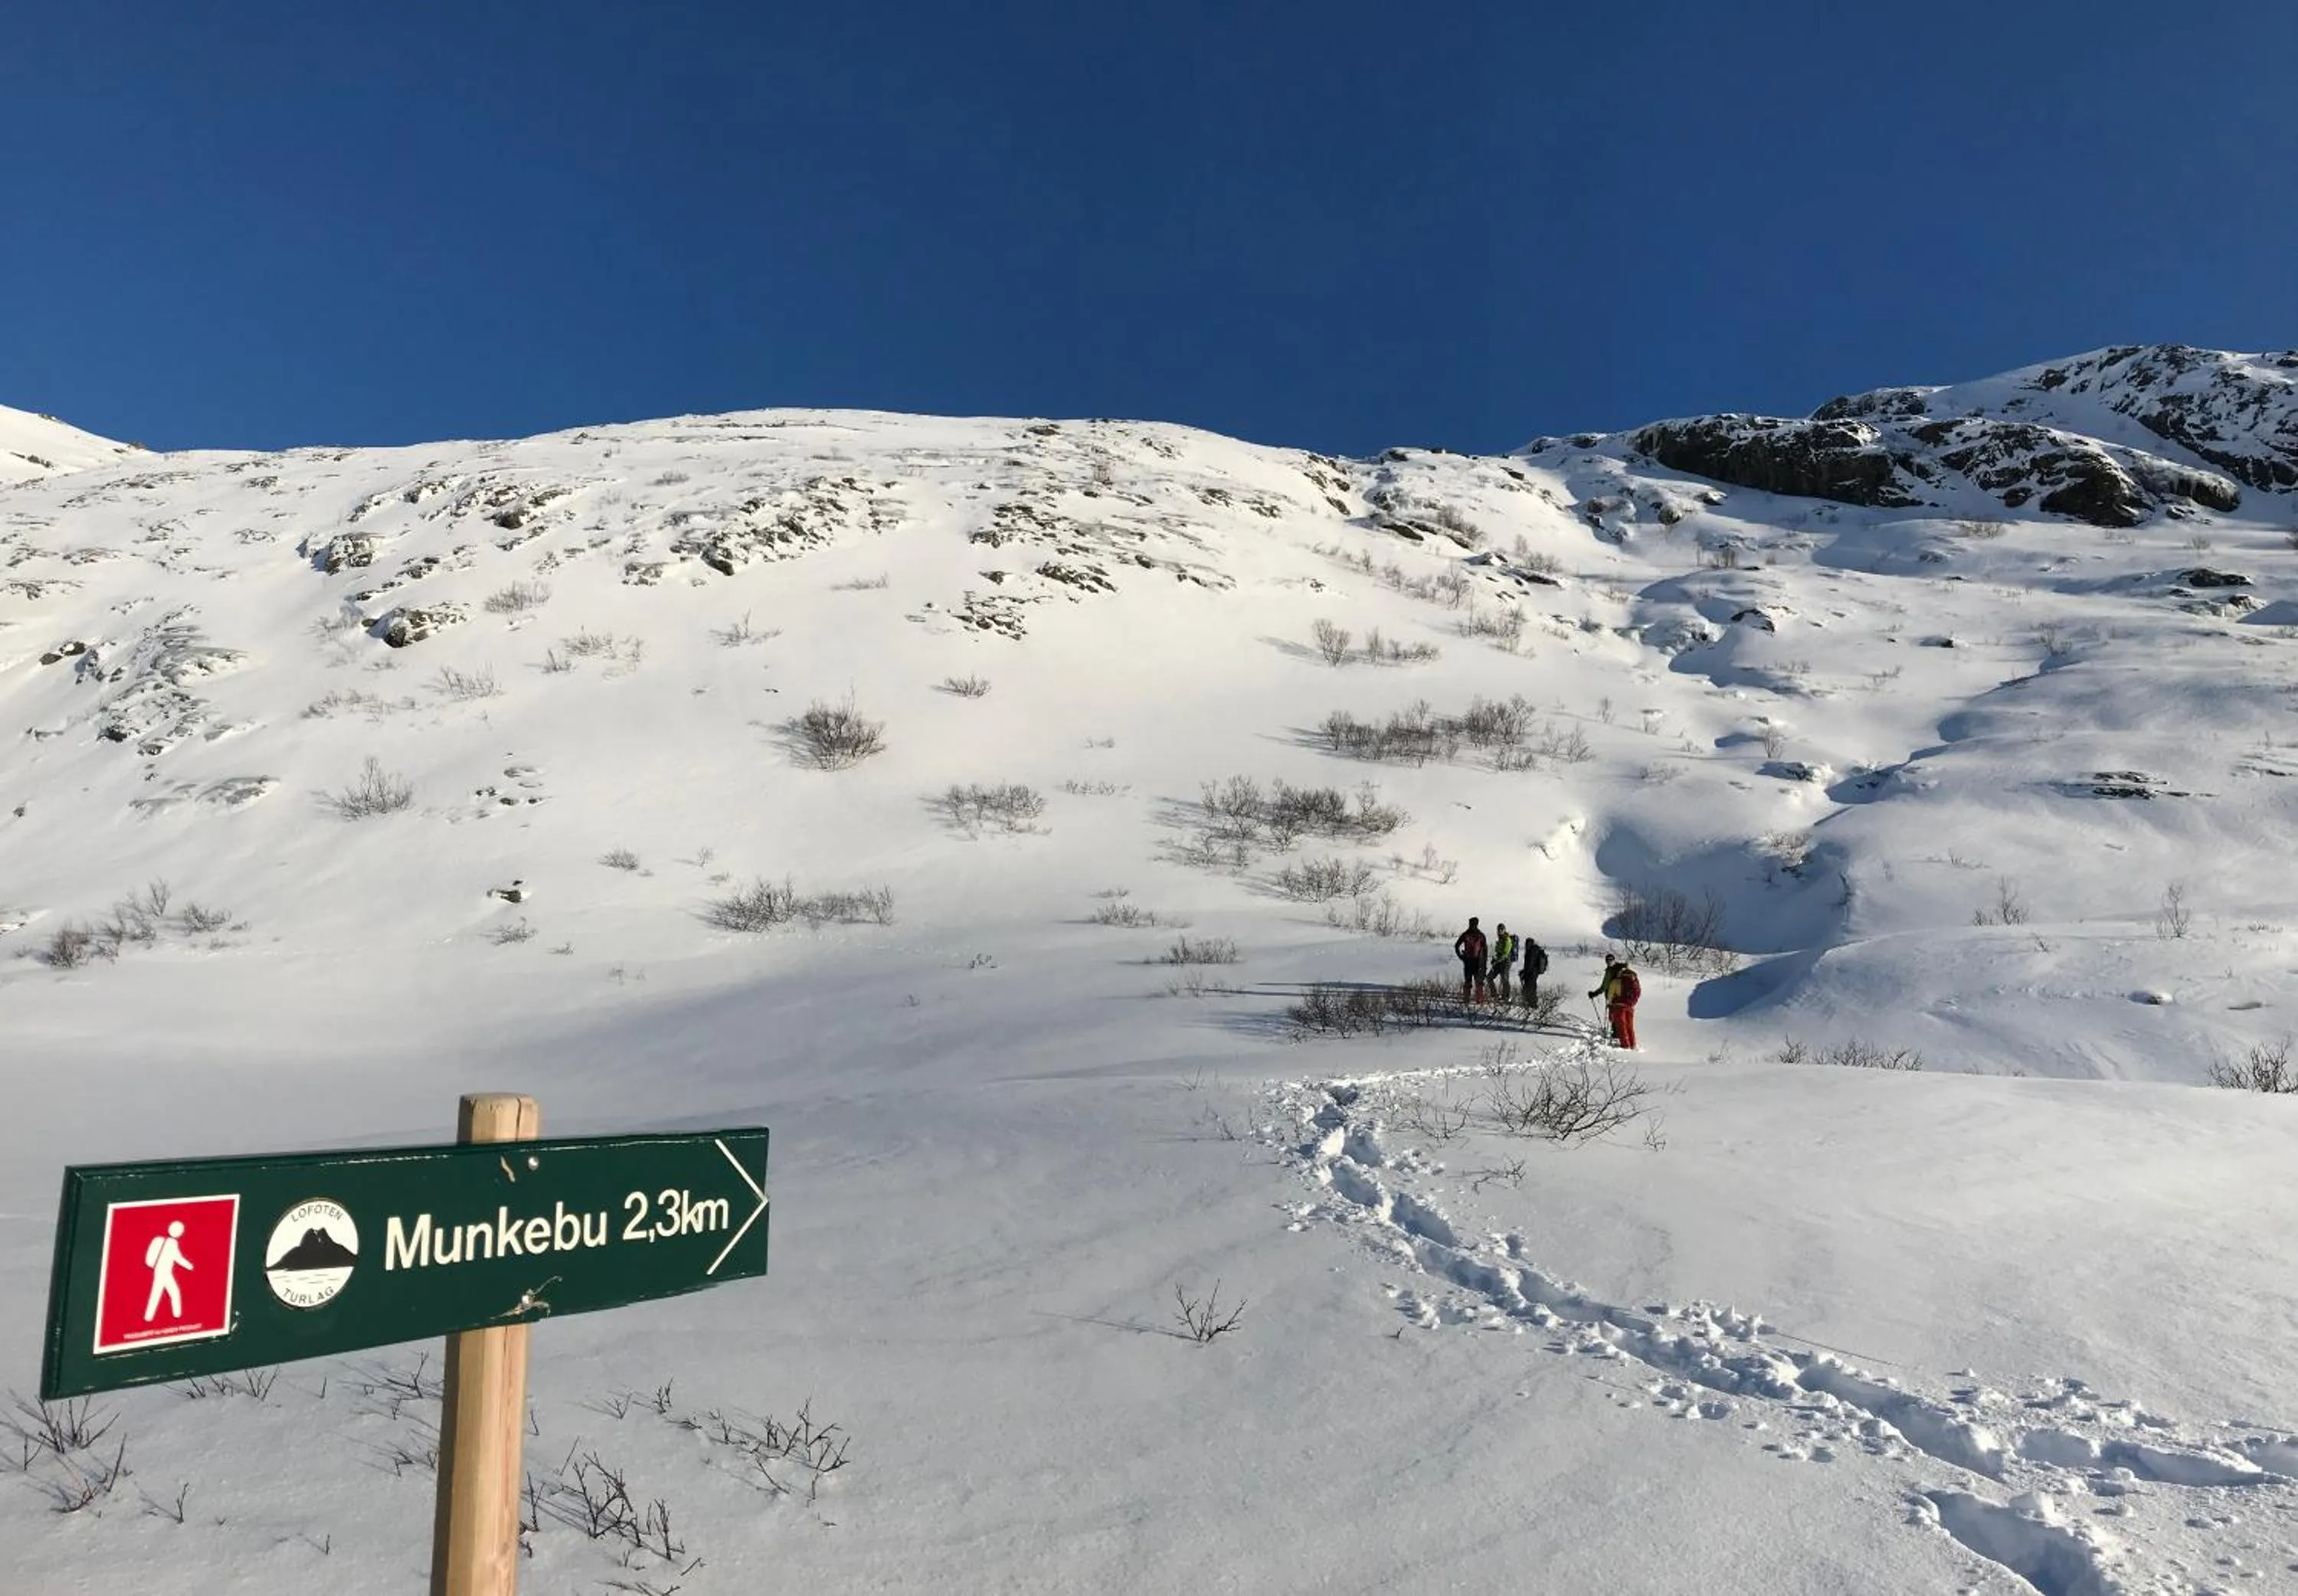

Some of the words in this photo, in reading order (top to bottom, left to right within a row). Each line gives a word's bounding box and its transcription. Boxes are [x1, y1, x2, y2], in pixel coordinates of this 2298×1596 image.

[291, 1204, 344, 1222] LOFOTEN
[385, 1201, 608, 1271] Munkebu
[621, 1188, 730, 1244] 2,3km
[283, 1286, 335, 1304] TURLAG
